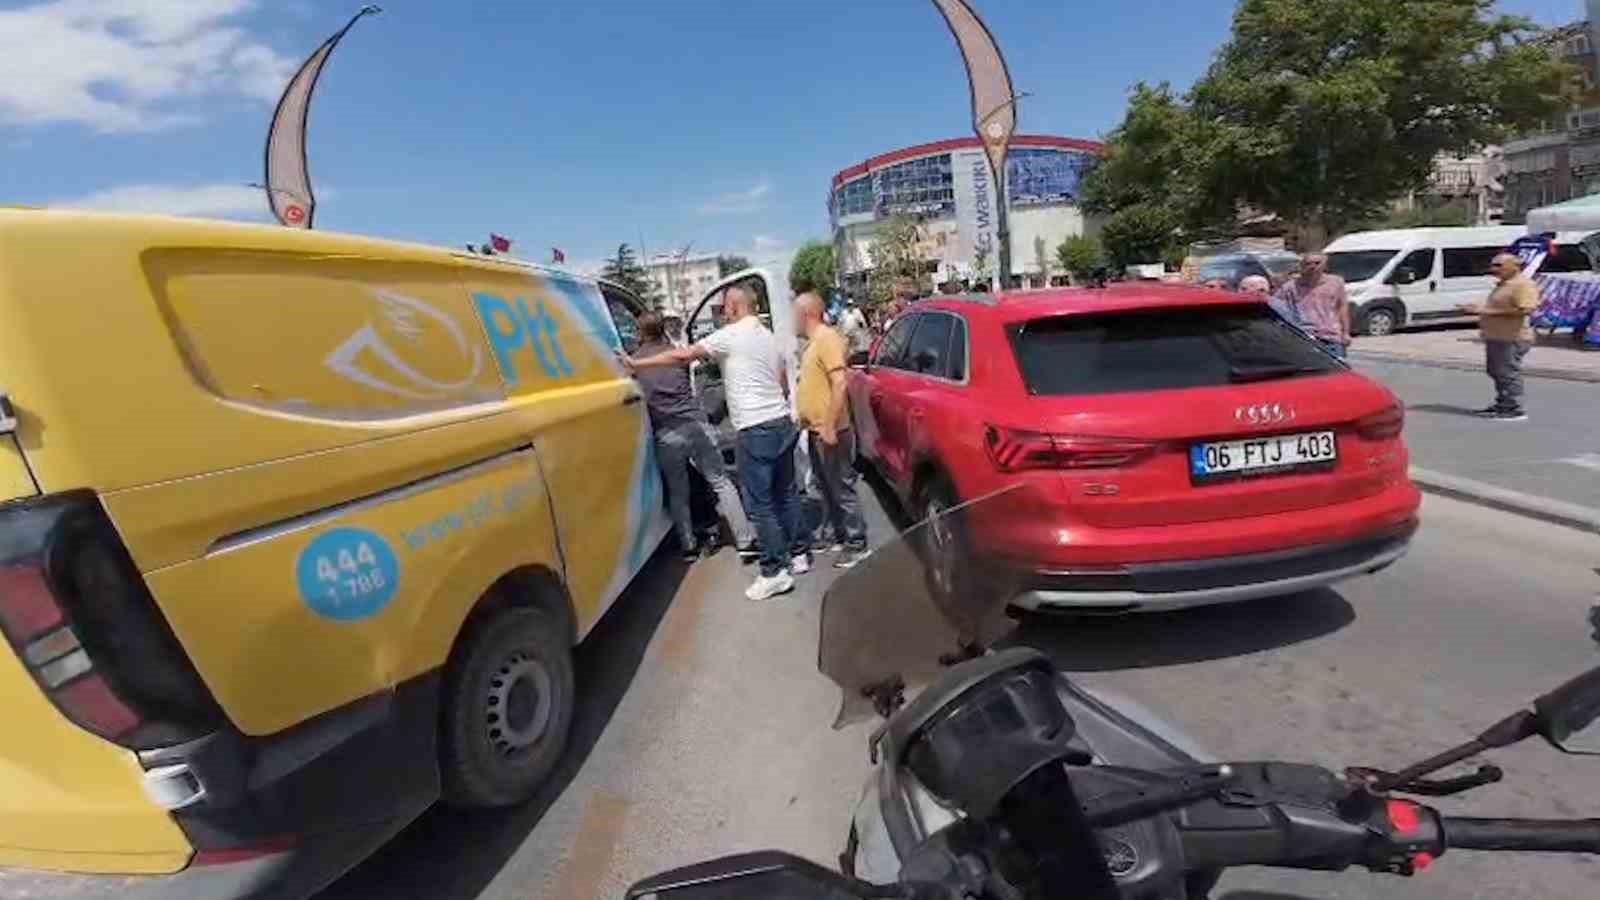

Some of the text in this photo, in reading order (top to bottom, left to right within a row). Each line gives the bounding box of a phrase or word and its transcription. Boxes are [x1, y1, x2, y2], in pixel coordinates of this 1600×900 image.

[1206, 435, 1333, 468] 06 FTJ 403
[316, 541, 377, 582] 444
